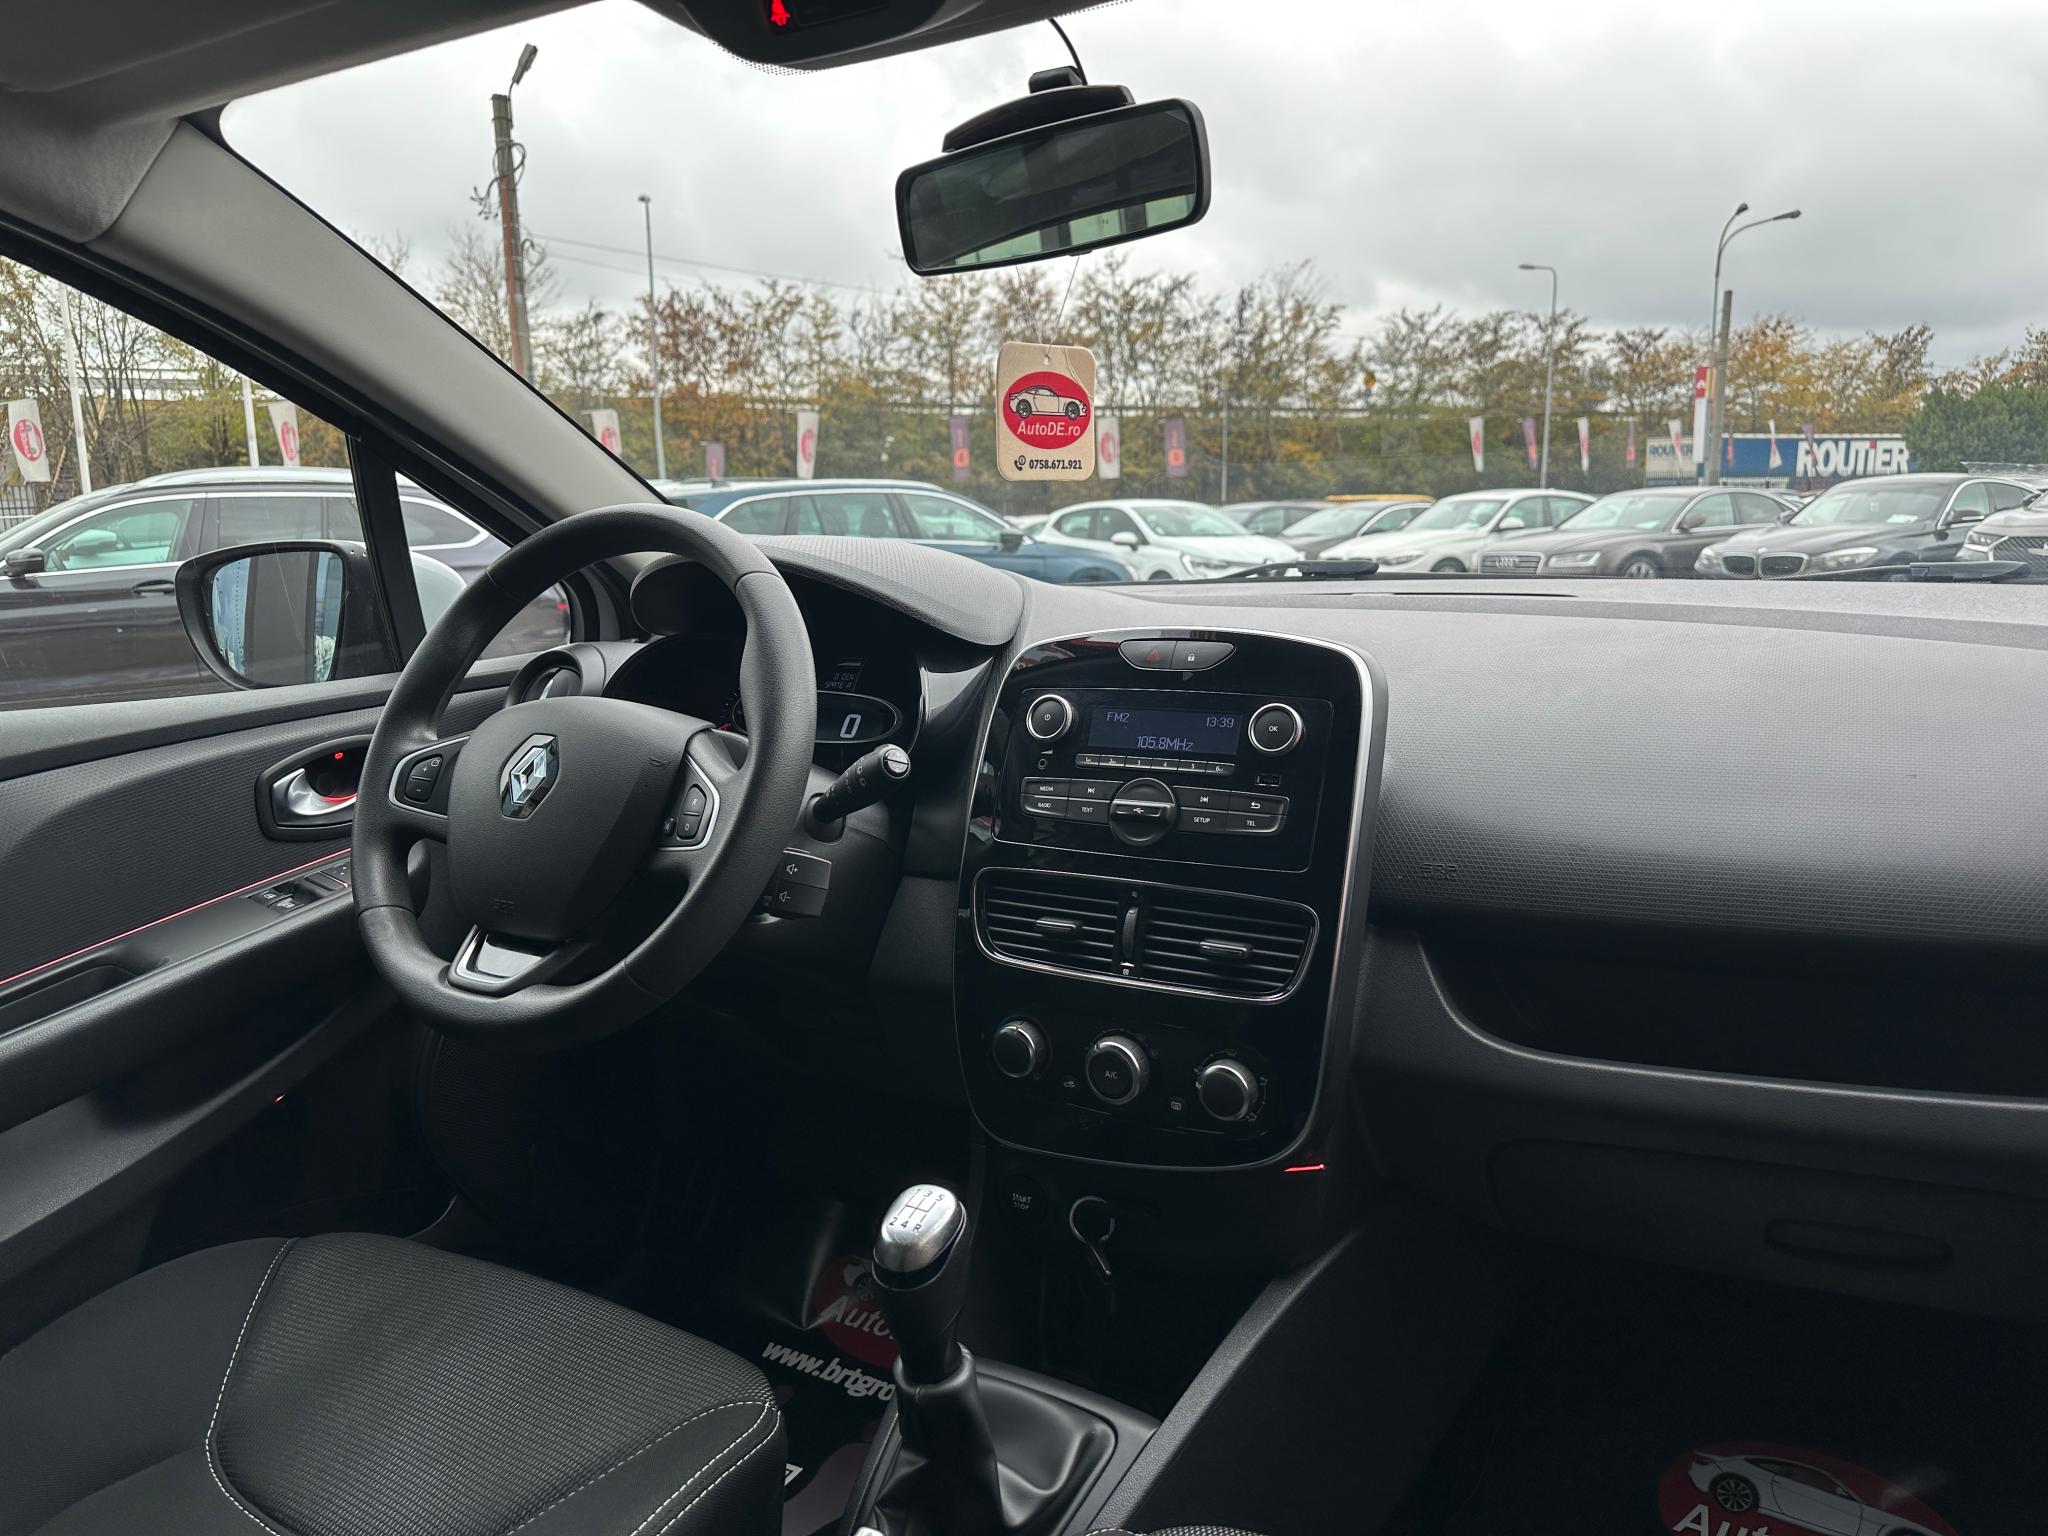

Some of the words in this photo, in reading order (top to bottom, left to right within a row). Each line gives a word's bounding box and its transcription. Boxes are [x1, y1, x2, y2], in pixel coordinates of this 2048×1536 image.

[1016, 420, 1081, 437] AutoDE.ro
[1029, 459, 1082, 470] 0758.671.921
[840, 713, 862, 739] 0
[1106, 711, 1130, 723] FM2
[1206, 716, 1234, 729] 13:39
[1137, 735, 1195, 752] 105.8MHz
[1193, 816, 1211, 824] SETUP
[1105, 1070, 1118, 1080] A/C
[1012, 1192, 1032, 1204] START
[1013, 1202, 1030, 1210] STOP
[818, 1295, 895, 1341] Auto
